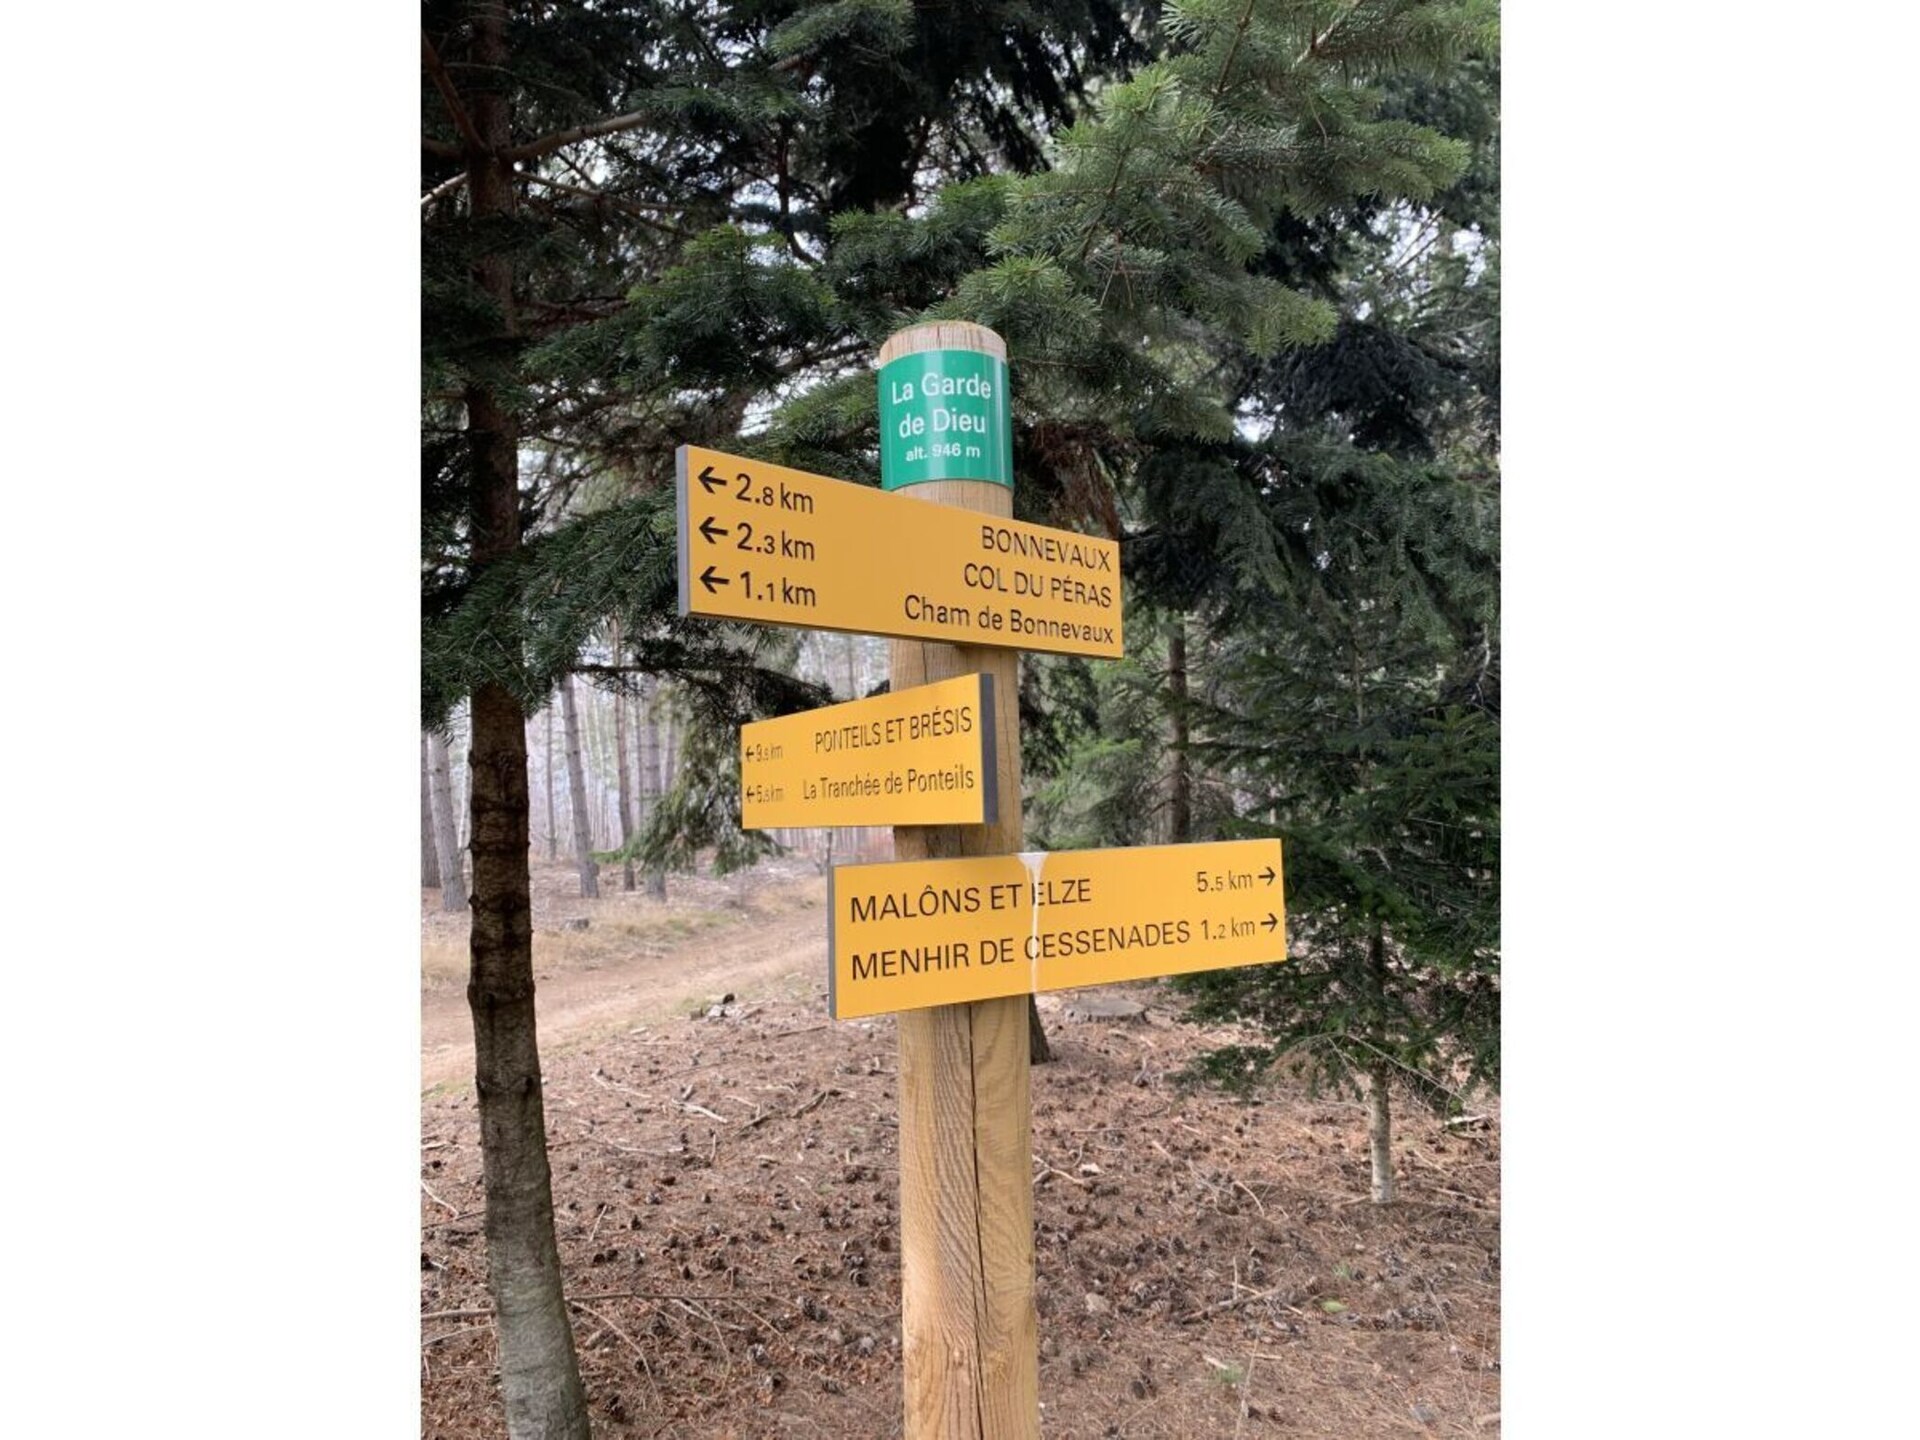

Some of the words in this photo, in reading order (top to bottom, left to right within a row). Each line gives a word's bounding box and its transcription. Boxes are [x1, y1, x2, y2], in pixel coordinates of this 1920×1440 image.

[891, 381, 914, 404] La
[921, 372, 991, 399] Garde
[899, 413, 925, 437] de
[932, 409, 985, 434] Dieu
[905, 448, 927, 461] alt.
[932, 443, 961, 458] 946
[966, 449, 981, 458] m
[736, 473, 773, 507] 2.8
[780, 482, 813, 514] km
[736, 523, 775, 555] 2.3
[782, 531, 815, 561] km
[982, 526, 1111, 573] BONNEVAUX
[741, 571, 775, 603] 1.1
[783, 576, 816, 607] km
[964, 563, 1007, 592] COL
[1015, 572, 1043, 597] DU
[1051, 575, 1111, 608] PÉRAS
[904, 594, 970, 628] Cham
[978, 603, 1003, 631] de
[1010, 612, 1113, 644] Bonnevaux
[815, 722, 881, 753] PONTEILS
[886, 718, 904, 743] ET
[910, 705, 972, 740] BRÉSIS
[803, 780, 817, 800] La
[820, 773, 880, 799] Tranchée
[885, 771, 902, 795] de
[908, 764, 974, 792] Ponteils
[1196, 872, 1224, 892] 5.5
[1228, 869, 1254, 891] km
[850, 885, 981, 923] MALÔNS
[990, 883, 1023, 911] ET
[1032, 878, 1092, 907] ELZE
[1201, 920, 1226, 940] 1.2
[1231, 916, 1256, 938] km
[851, 943, 970, 981] MENHIR
[980, 938, 1014, 965] DE
[1024, 920, 1191, 960] CESSENADES
